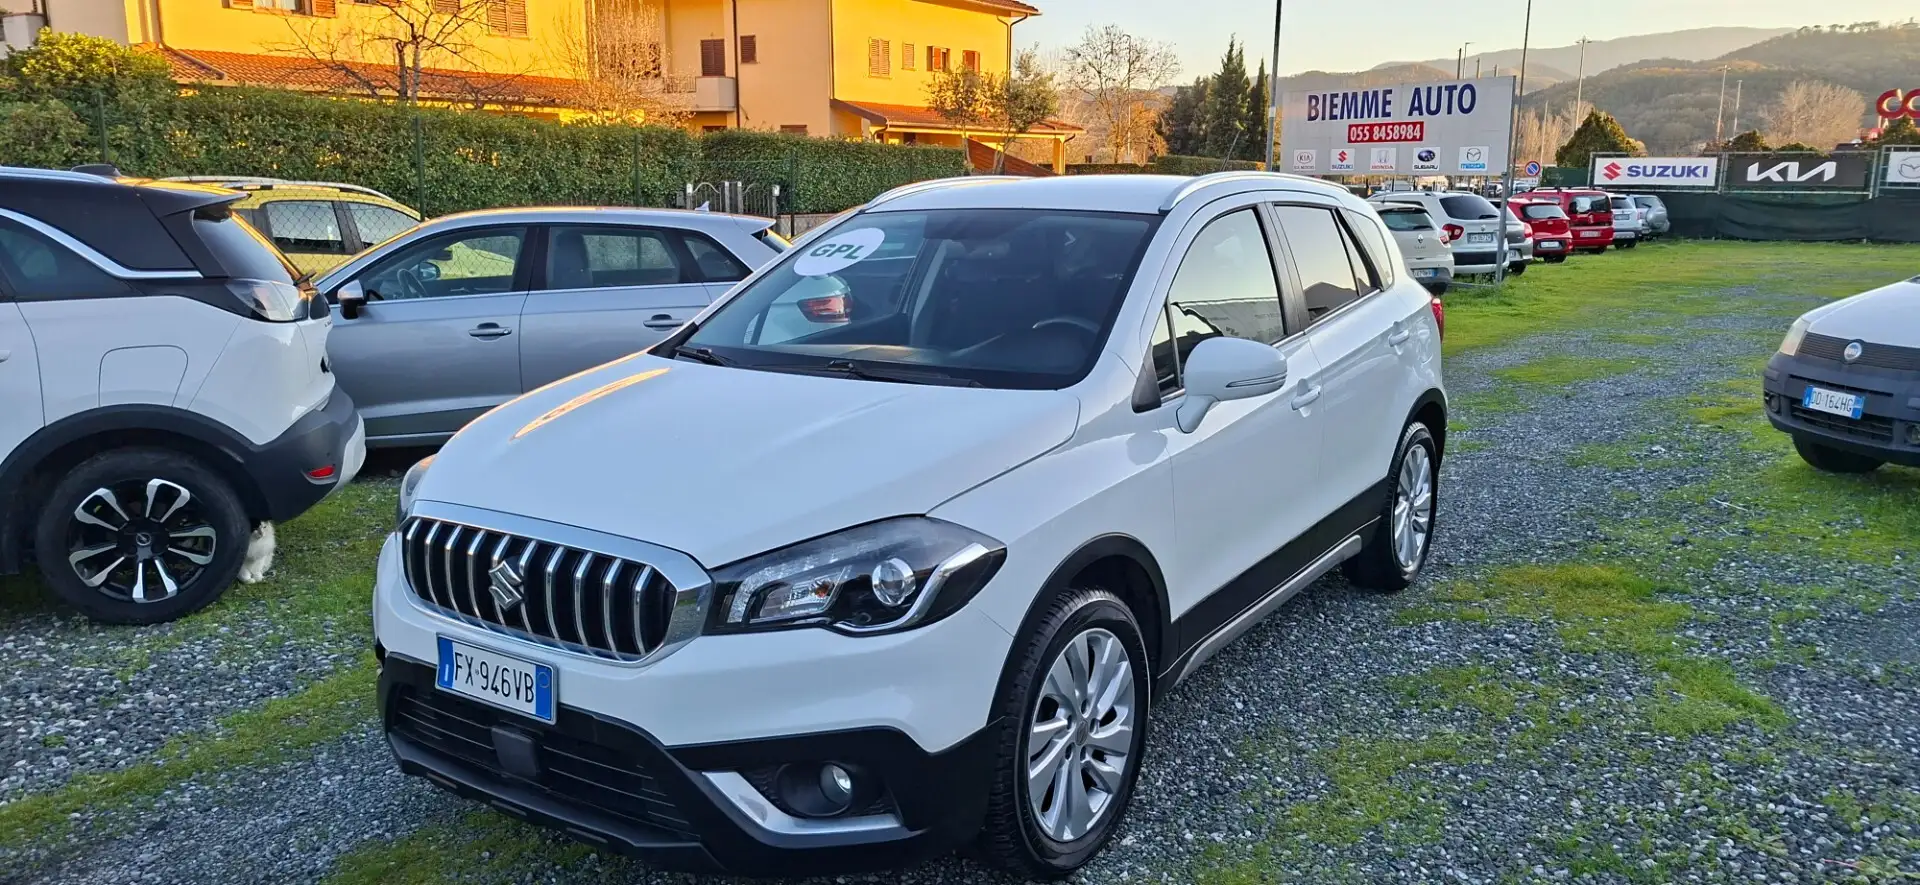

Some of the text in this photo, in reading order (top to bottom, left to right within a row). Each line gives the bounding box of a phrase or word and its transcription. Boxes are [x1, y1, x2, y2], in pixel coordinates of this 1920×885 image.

[1307, 83, 1477, 121] BIEMME AUTO
[1350, 124, 1421, 141] 055 8458984
[1627, 164, 1709, 178] SUZUKI
[809, 243, 865, 260] GPL
